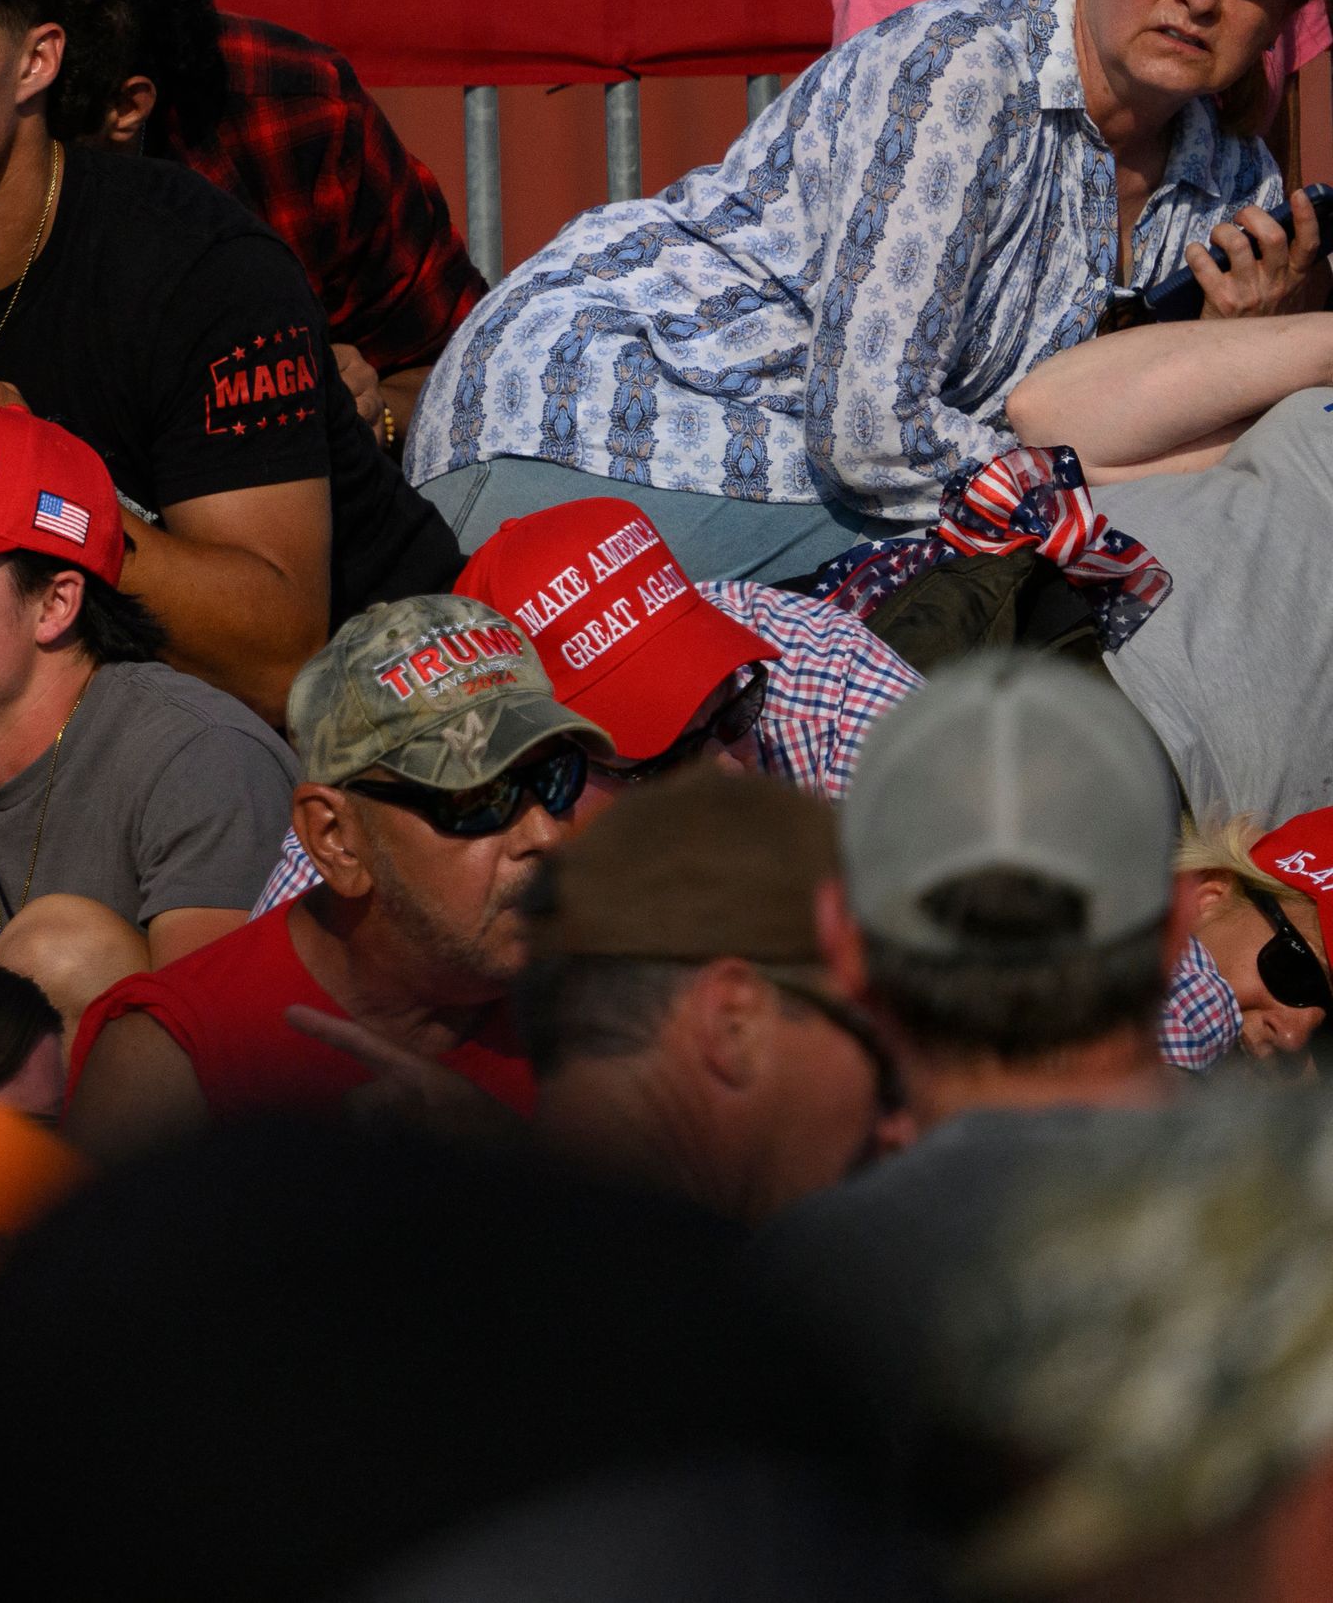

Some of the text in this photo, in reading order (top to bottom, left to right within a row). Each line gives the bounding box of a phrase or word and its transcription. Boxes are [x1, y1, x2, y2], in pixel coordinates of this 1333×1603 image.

[216, 355, 315, 409] MAGA
[515, 565, 591, 638] MAKE
[377, 626, 524, 702] TRUMP
[561, 597, 640, 670] GREAT
[428, 672, 469, 698] SAVE
[462, 670, 518, 696] 2024
